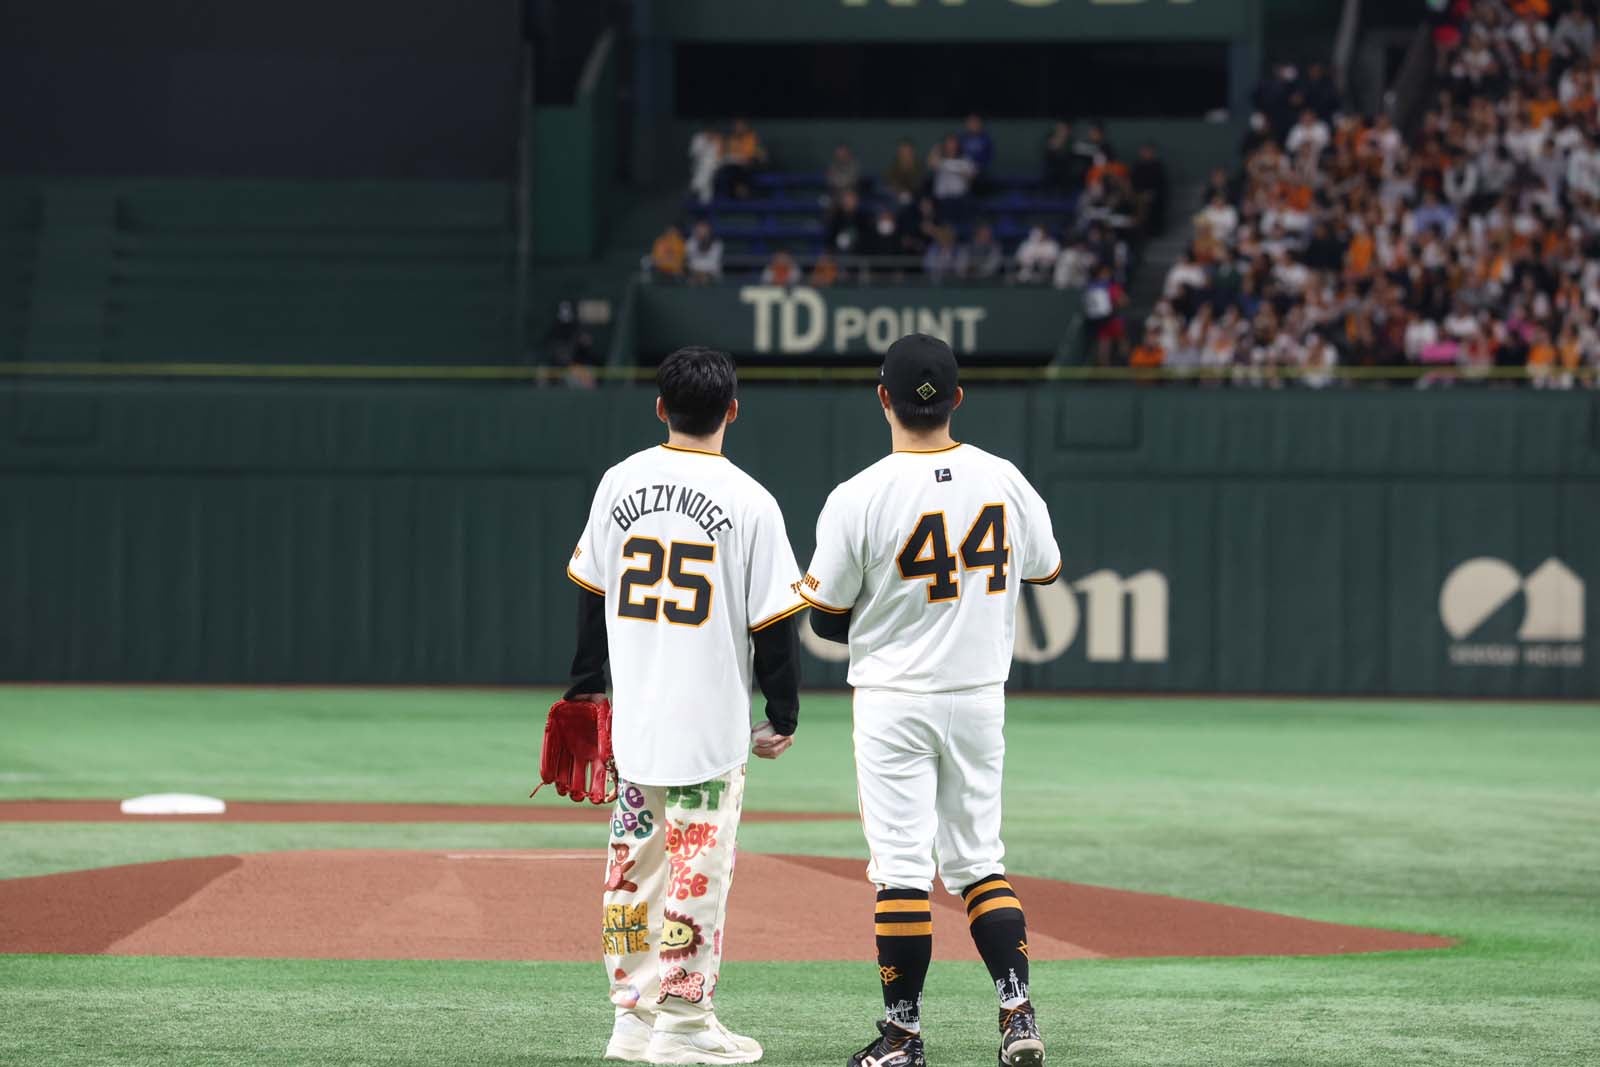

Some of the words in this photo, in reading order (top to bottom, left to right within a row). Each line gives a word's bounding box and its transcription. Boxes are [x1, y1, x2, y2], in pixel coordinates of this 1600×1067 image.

[740, 285, 827, 354] TD
[612, 484, 676, 532] BUZZY
[676, 486, 733, 542] NOISE
[896, 502, 1013, 604] 44
[617, 535, 717, 628] 25
